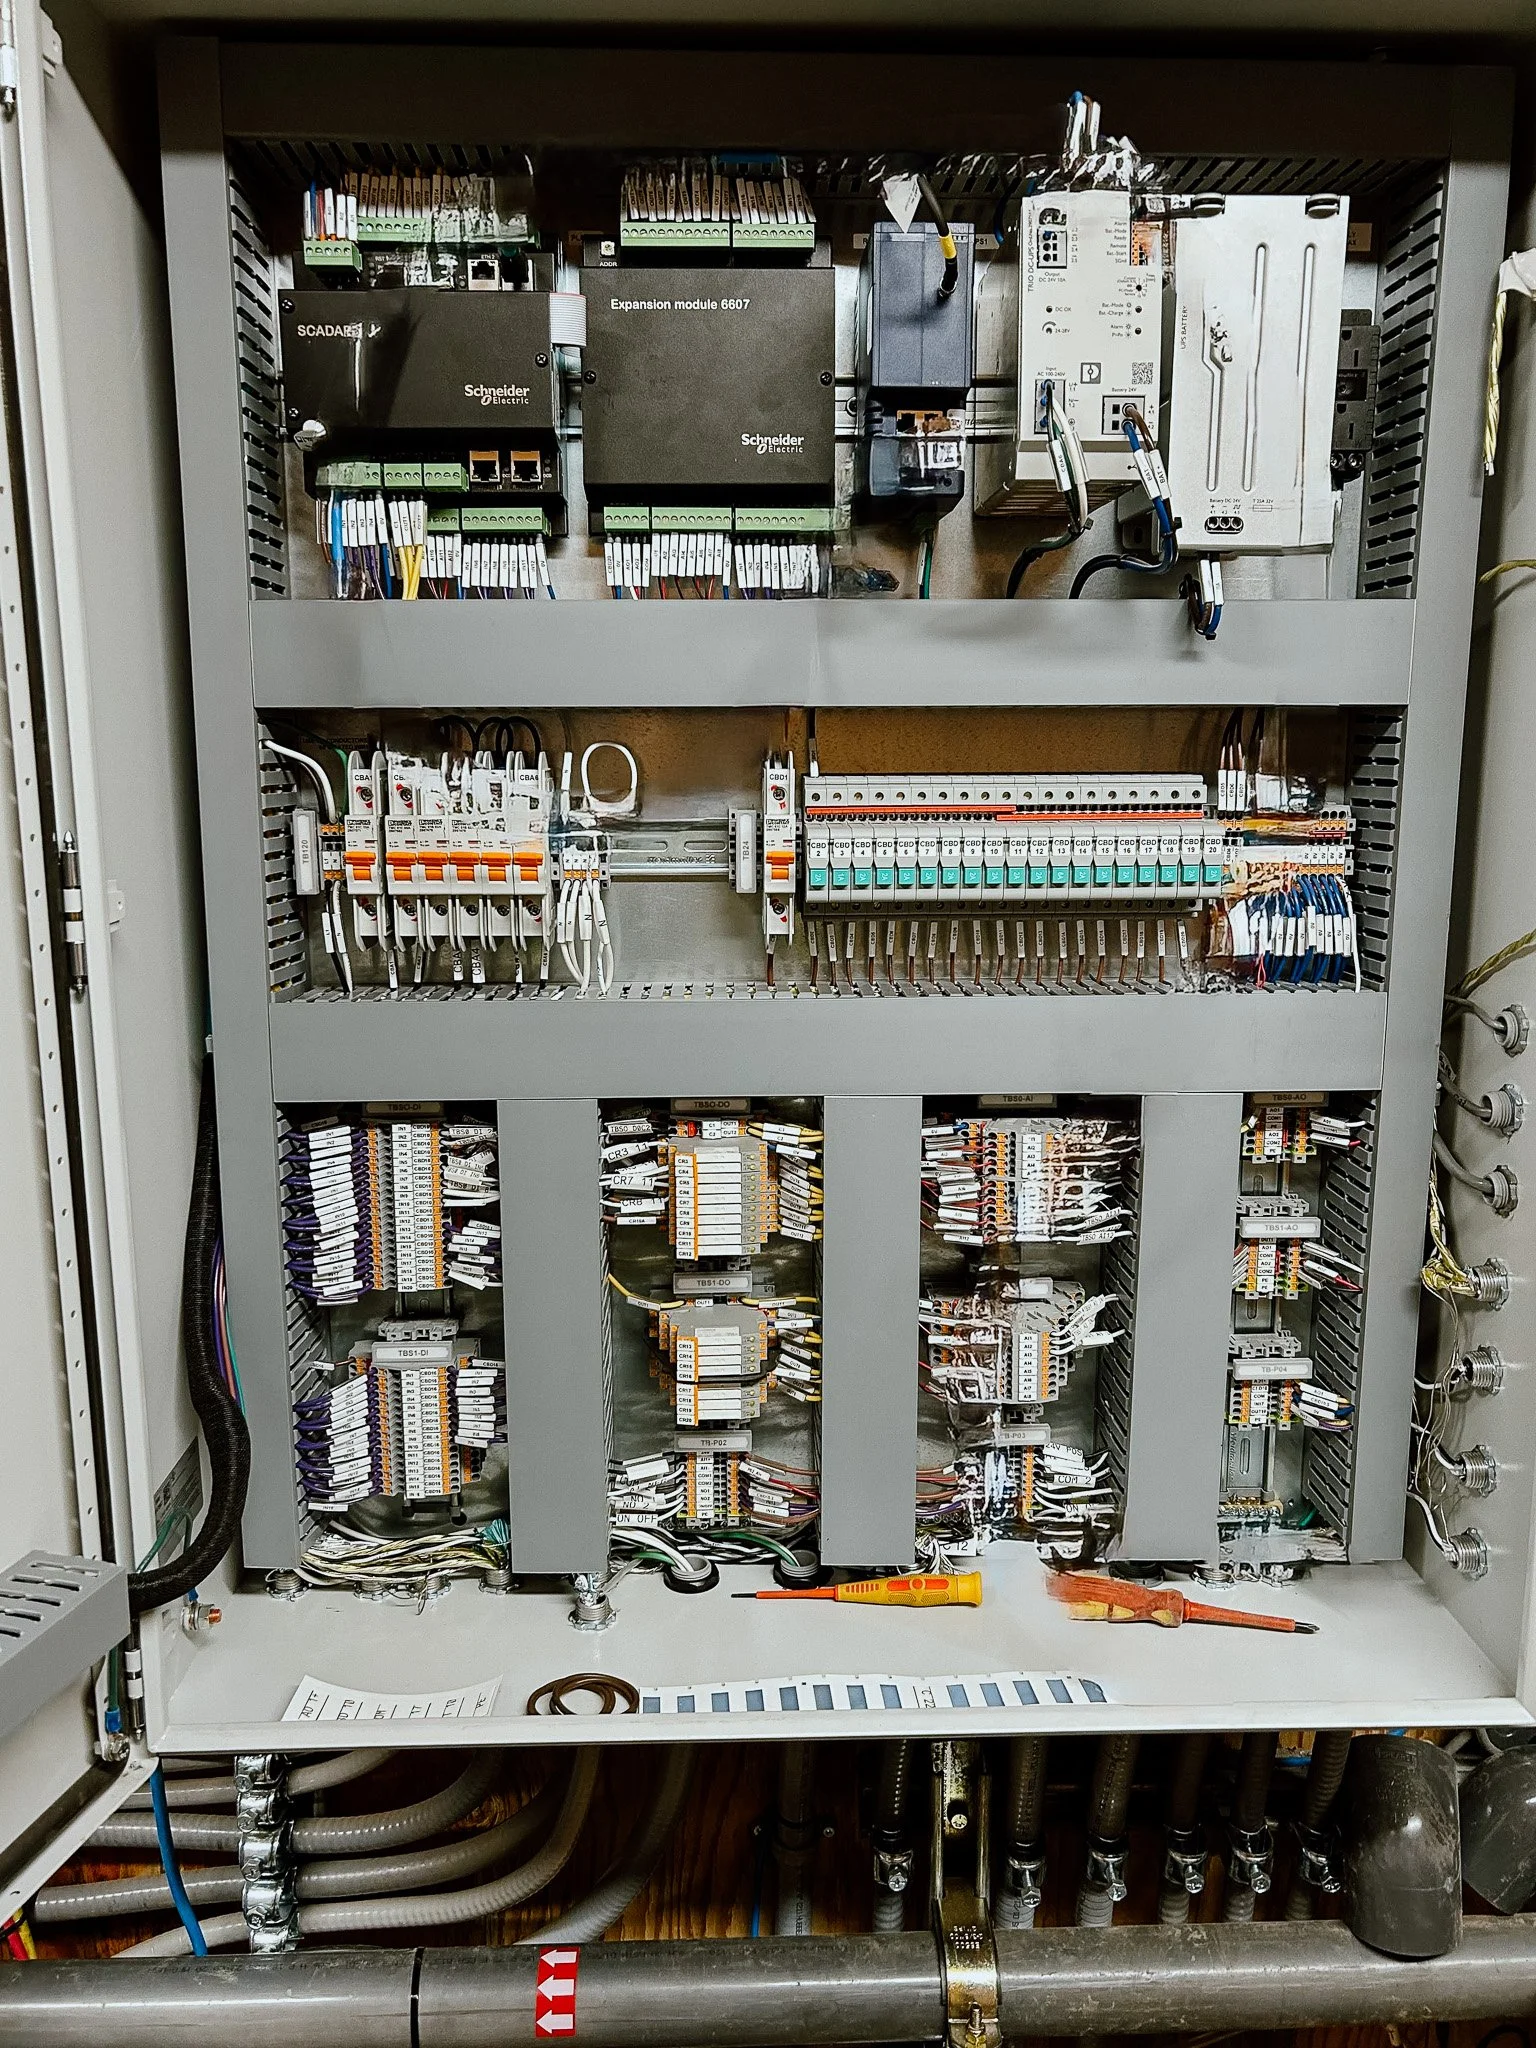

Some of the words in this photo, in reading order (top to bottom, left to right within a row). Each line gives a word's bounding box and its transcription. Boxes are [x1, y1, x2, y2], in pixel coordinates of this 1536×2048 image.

[610, 298, 671, 312] Expansion
[674, 298, 718, 310] module
[721, 298, 750, 310] 6607
[464, 384, 530, 398] Schneider
[492, 397, 530, 405] Electric
[742, 434, 804, 446] Schneider
[815, 874, 821, 882] 2A
[838, 873, 844, 882] 1A
[860, 873, 866, 881] 2A
[903, 873, 910, 881] 2A
[947, 872, 953, 880] 2A
[992, 872, 998, 880] 2A
[1036, 872, 1042, 880] 2A
[608, 1148, 628, 1160] CR3
[635, 1143, 647, 1152] 11
[613, 1176, 633, 1185] CR7
[642, 1178, 653, 1187] 11
[1085, 1476, 1091, 1484] 2
